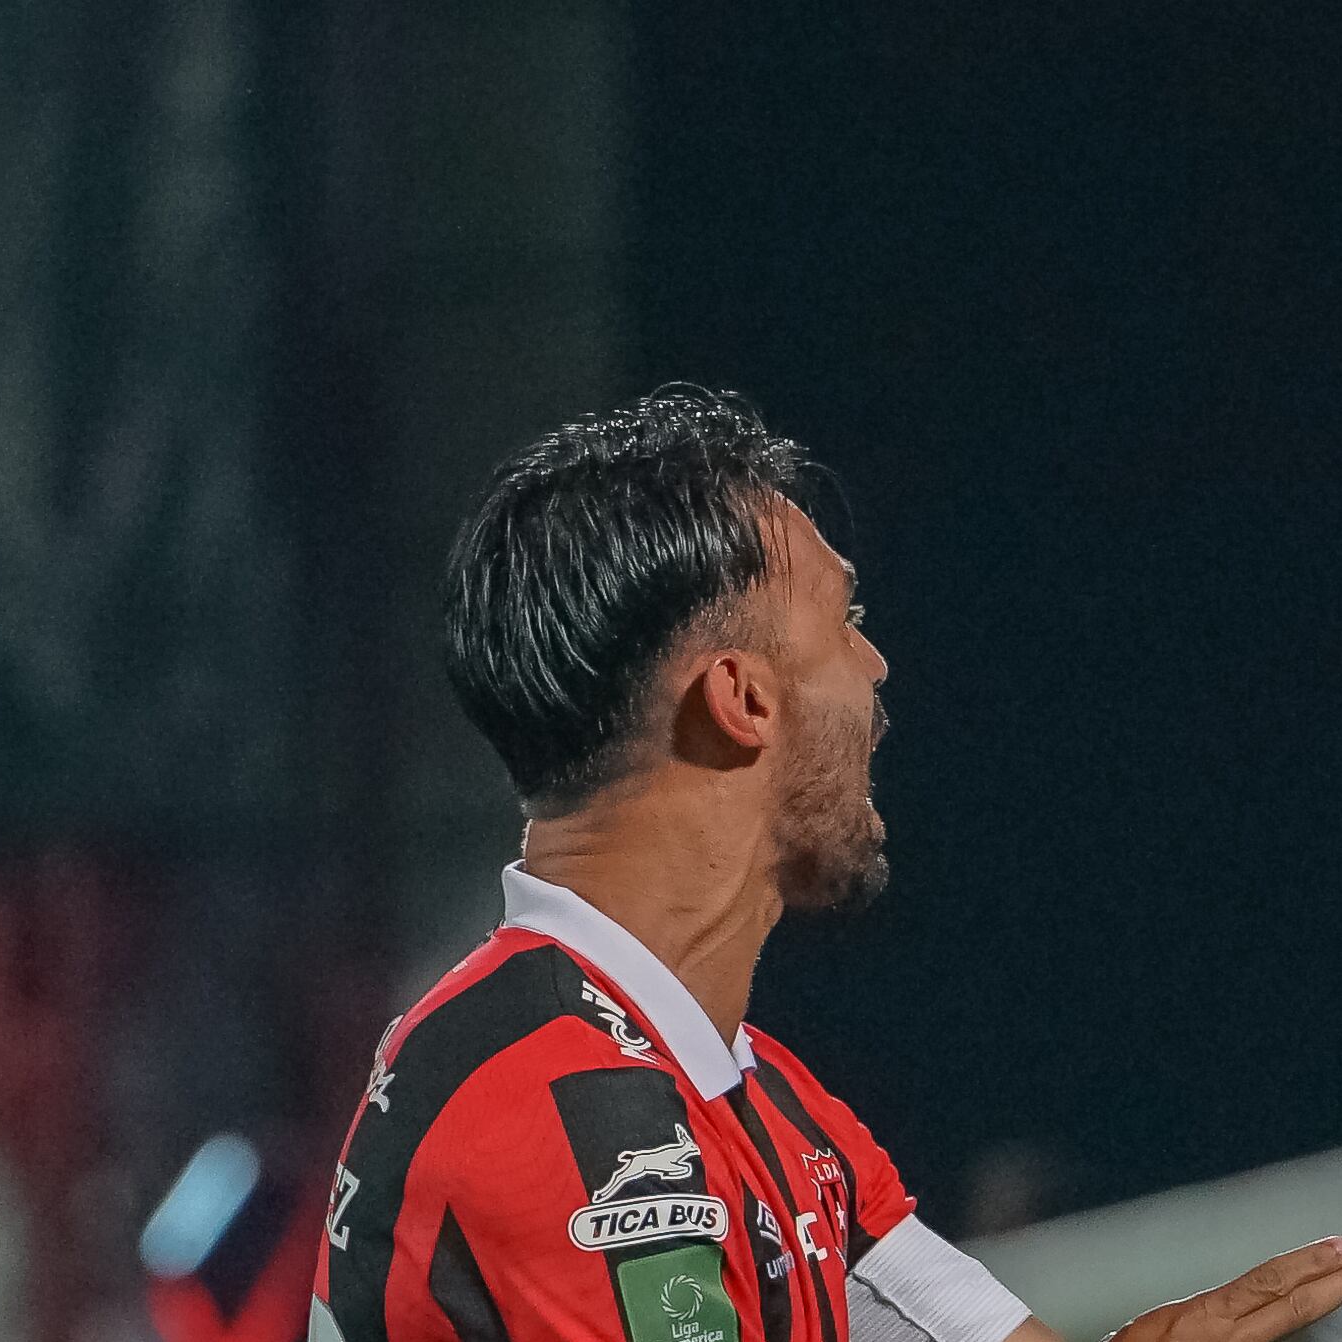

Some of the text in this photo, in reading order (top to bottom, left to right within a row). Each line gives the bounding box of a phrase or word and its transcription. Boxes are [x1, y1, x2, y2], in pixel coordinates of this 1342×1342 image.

[814, 1162, 841, 1181] LDA
[590, 1204, 718, 1239] TICA BUS
[671, 1320, 700, 1339] Liga
